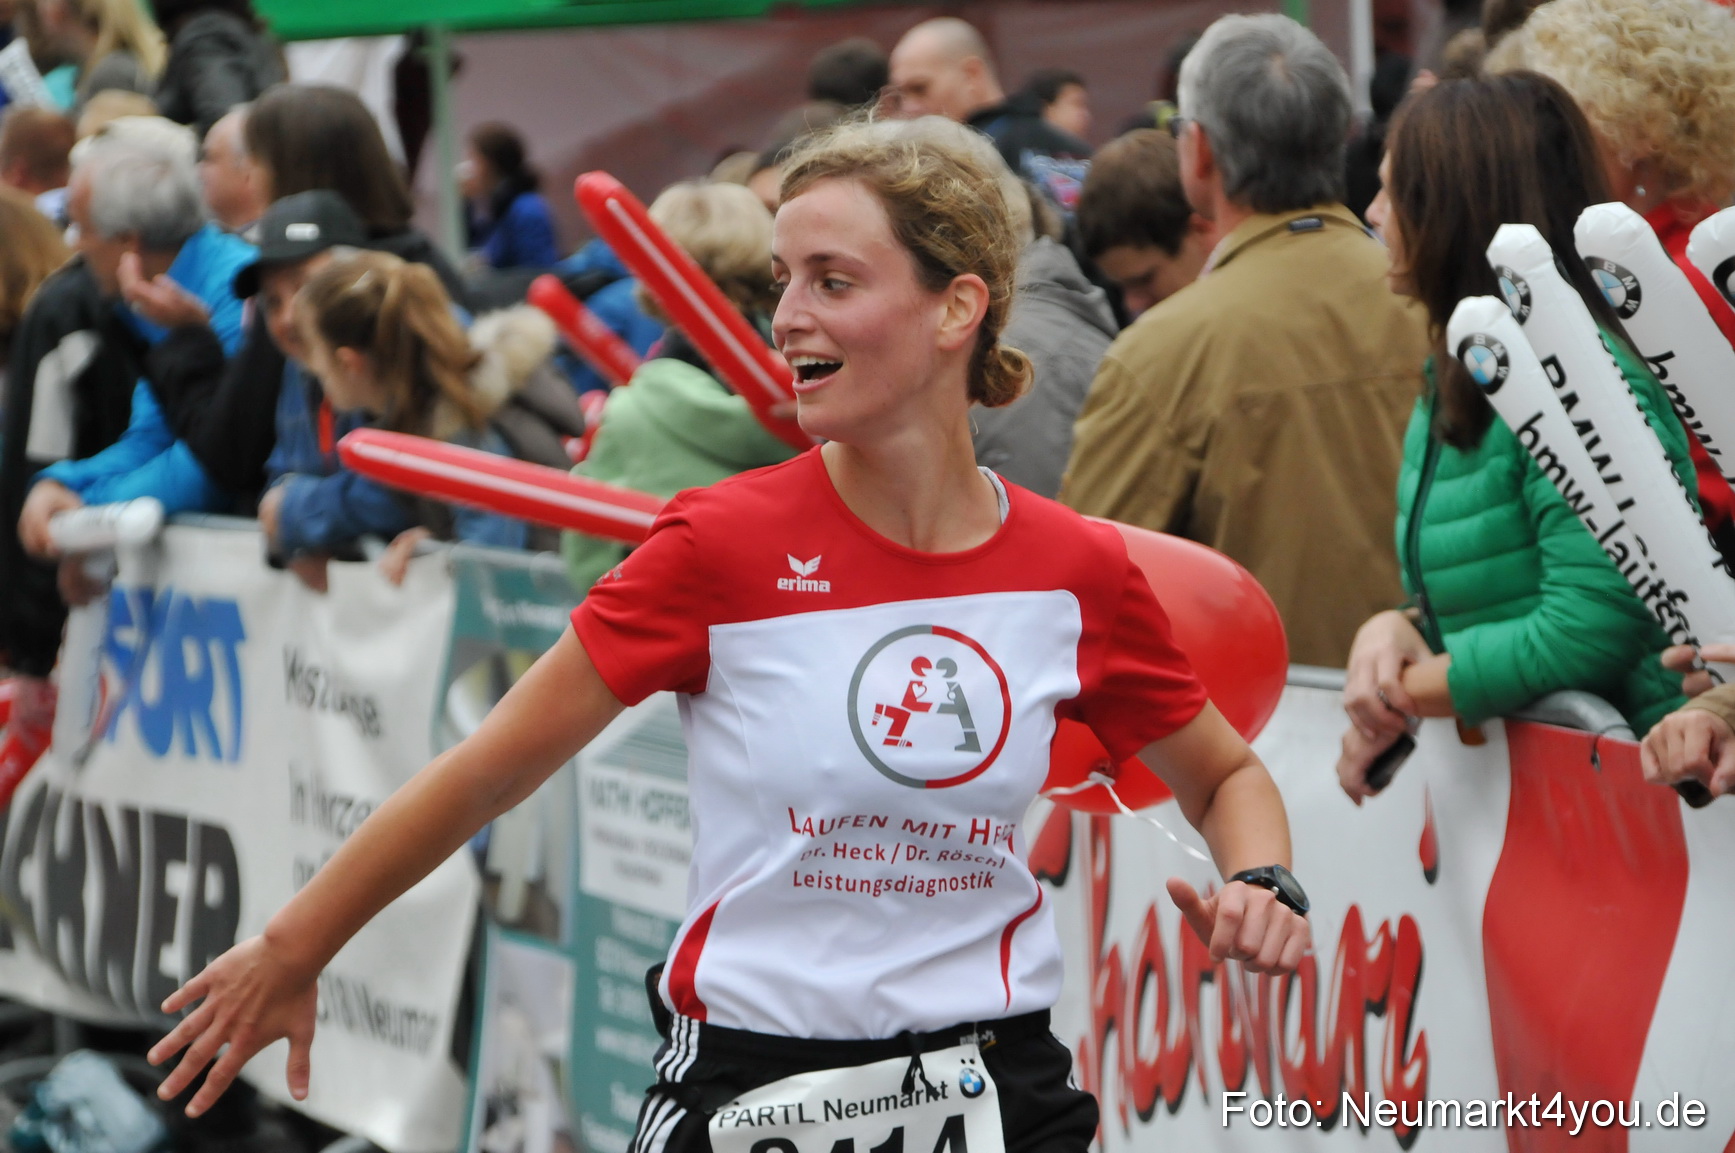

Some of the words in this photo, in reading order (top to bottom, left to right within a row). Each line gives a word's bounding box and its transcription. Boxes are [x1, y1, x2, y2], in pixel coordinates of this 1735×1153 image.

[777, 575, 831, 593] erima
[787, 806, 889, 838] LAUFEN
[901, 818, 957, 840] MIT
[833, 842, 886, 861] Heck
[906, 844, 930, 862] Dr.
[793, 869, 995, 898] Leistungsdiagnostik
[717, 1101, 816, 1129] PARTL
